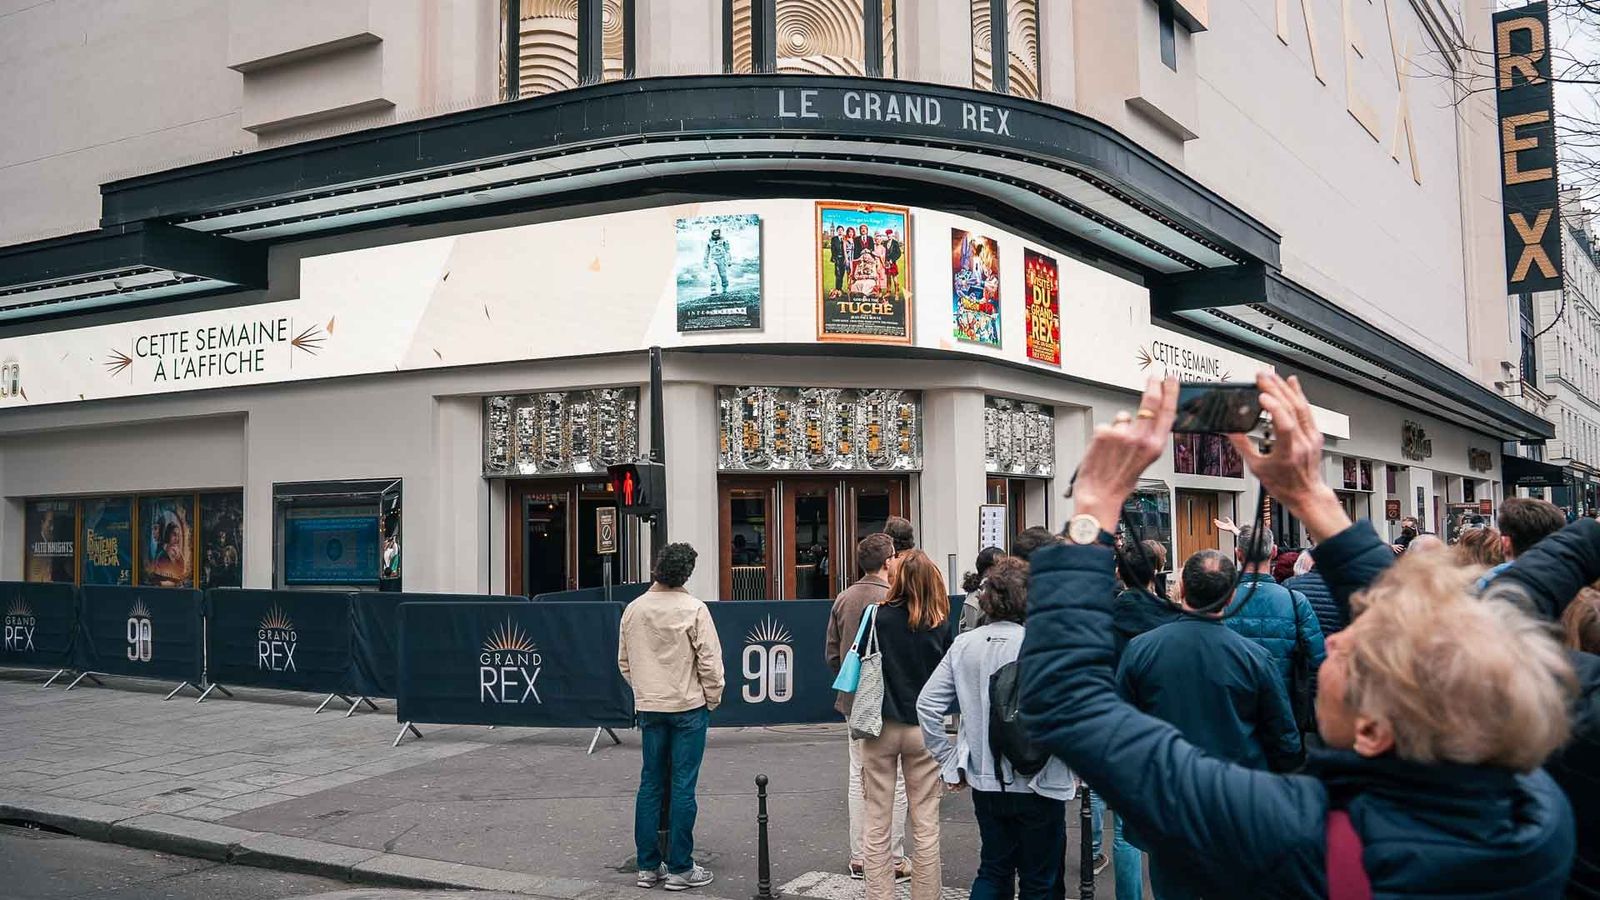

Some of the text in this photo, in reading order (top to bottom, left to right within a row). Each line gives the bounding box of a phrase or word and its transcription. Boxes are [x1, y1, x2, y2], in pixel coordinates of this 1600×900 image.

[778, 89, 1011, 137] LE GRAND REX
[1496, 16, 1560, 283] REX
[1031, 303, 1053, 320] GRAND
[1033, 284, 1051, 308] DU
[135, 318, 288, 358] CETTE SEMAINE
[1032, 315, 1053, 343] REX
[153, 348, 265, 382] À L'AFFICHE
[1152, 340, 1180, 366] CETTE
[1182, 348, 1220, 377] SEMAINE
[4, 615, 36, 626] GRAND
[258, 629, 297, 642] GRAND
[5, 625, 36, 653] REX
[126, 617, 152, 662] 90
[258, 641, 297, 673] REX
[479, 652, 542, 666] GRAND
[480, 666, 542, 704] REX
[742, 644, 794, 704] 90
